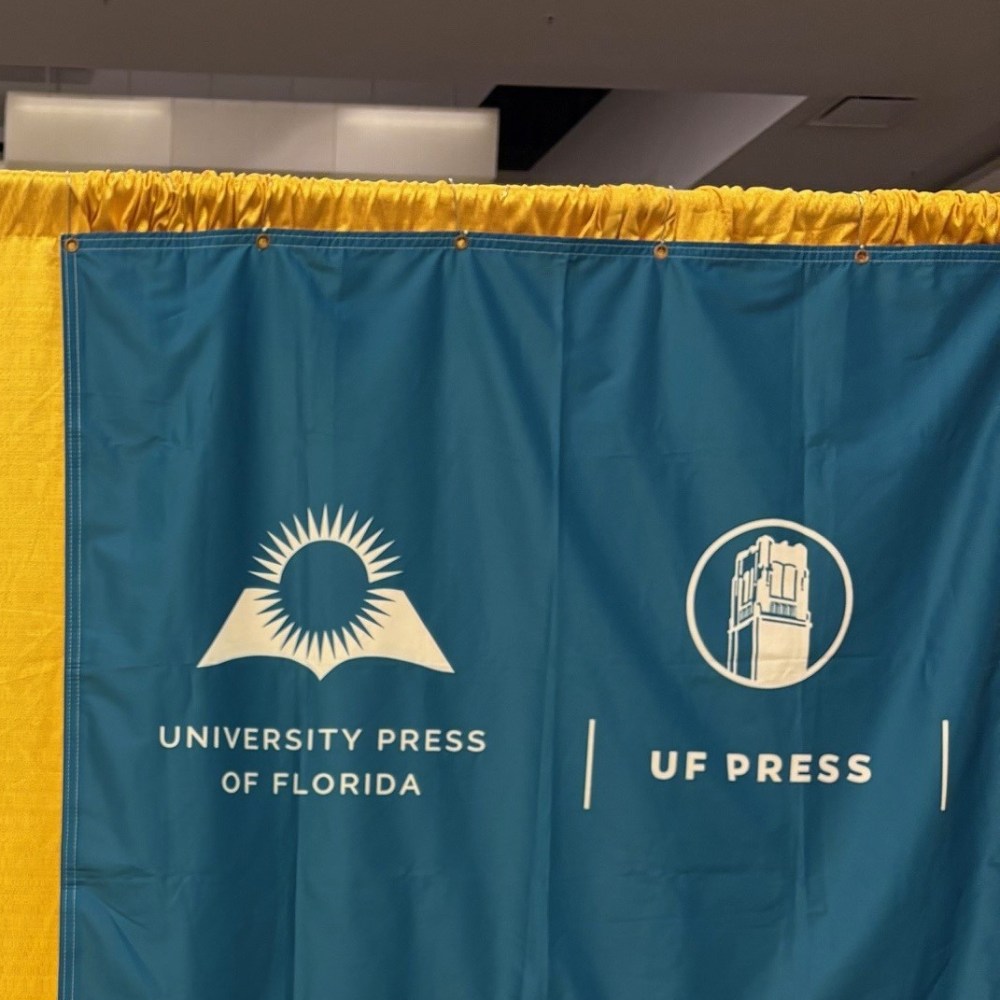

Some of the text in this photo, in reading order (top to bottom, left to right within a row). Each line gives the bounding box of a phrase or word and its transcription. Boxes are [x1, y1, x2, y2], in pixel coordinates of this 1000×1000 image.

[158, 726, 487, 752] UNIVERSITY PRESS
[650, 750, 873, 784] UF PRESS
[221, 770, 421, 797] OF FLORIDA
